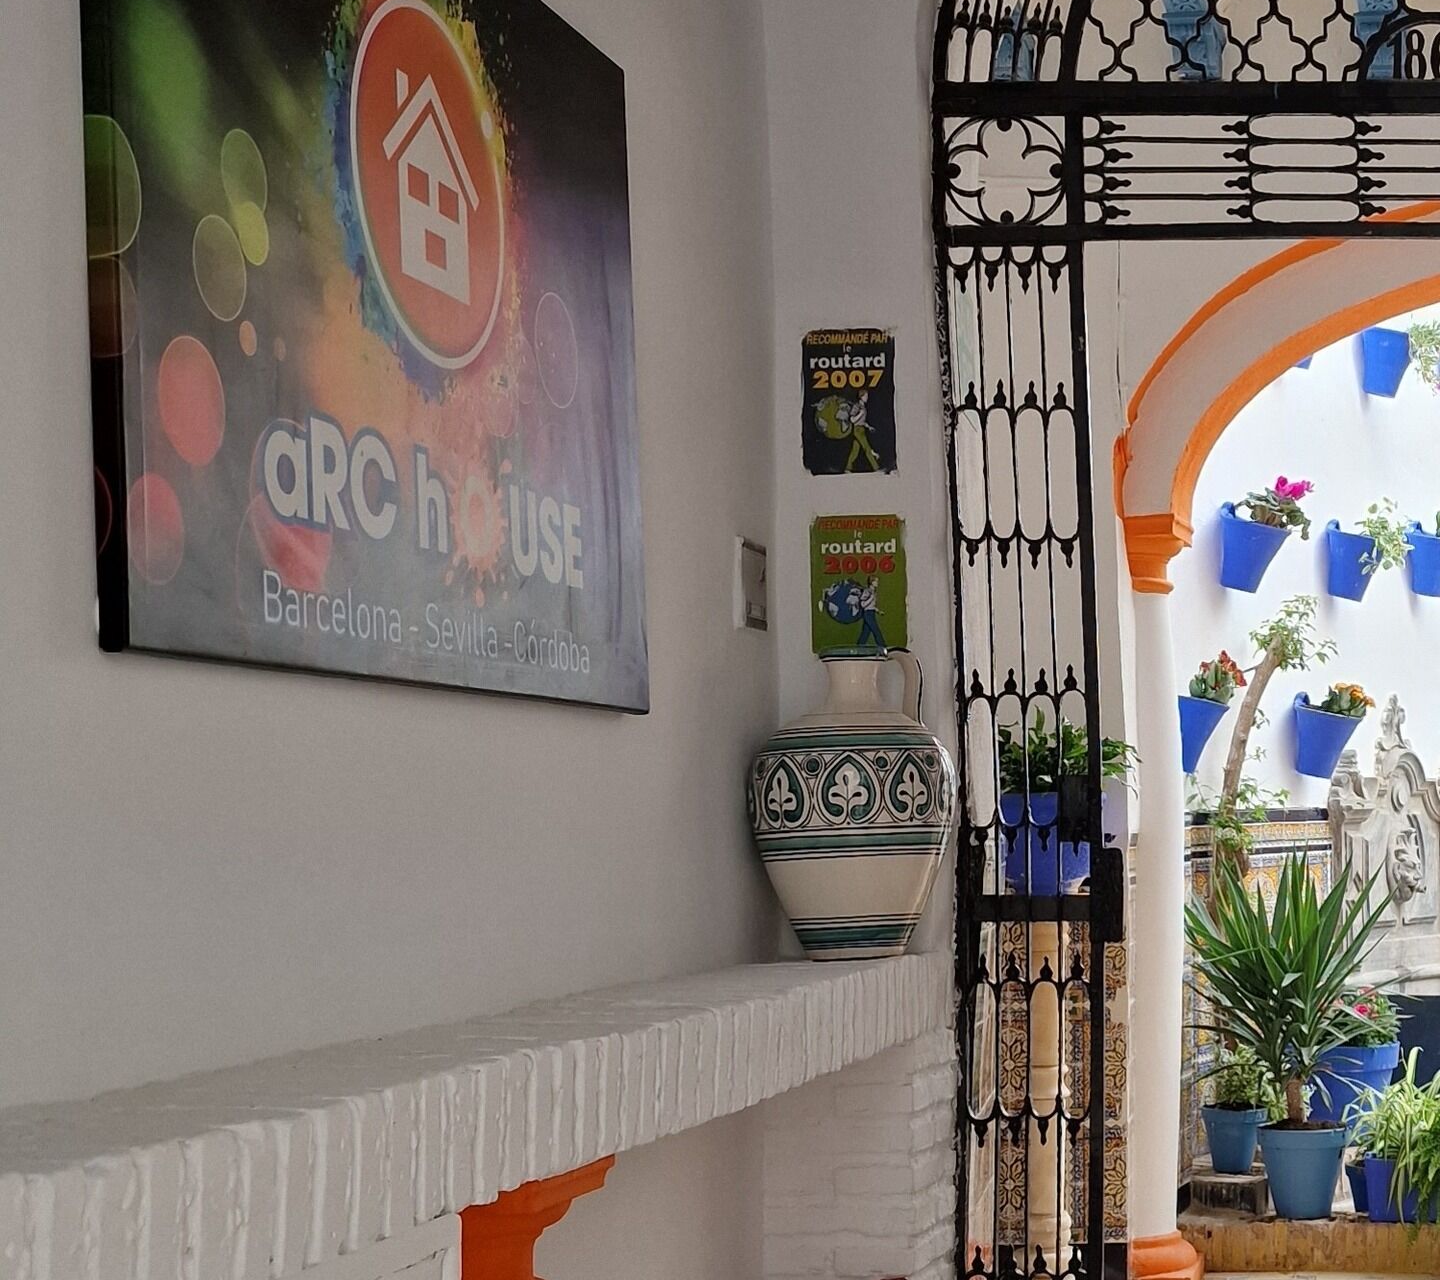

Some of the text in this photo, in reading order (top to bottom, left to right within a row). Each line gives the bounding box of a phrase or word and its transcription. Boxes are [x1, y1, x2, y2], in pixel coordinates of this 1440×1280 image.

[809, 352, 886, 369] routard
[812, 369, 884, 389] 2007
[821, 538, 896, 554] routard
[823, 554, 896, 575] 2006
[263, 569, 402, 643] Barcelona
[425, 602, 498, 658] Sevilla
